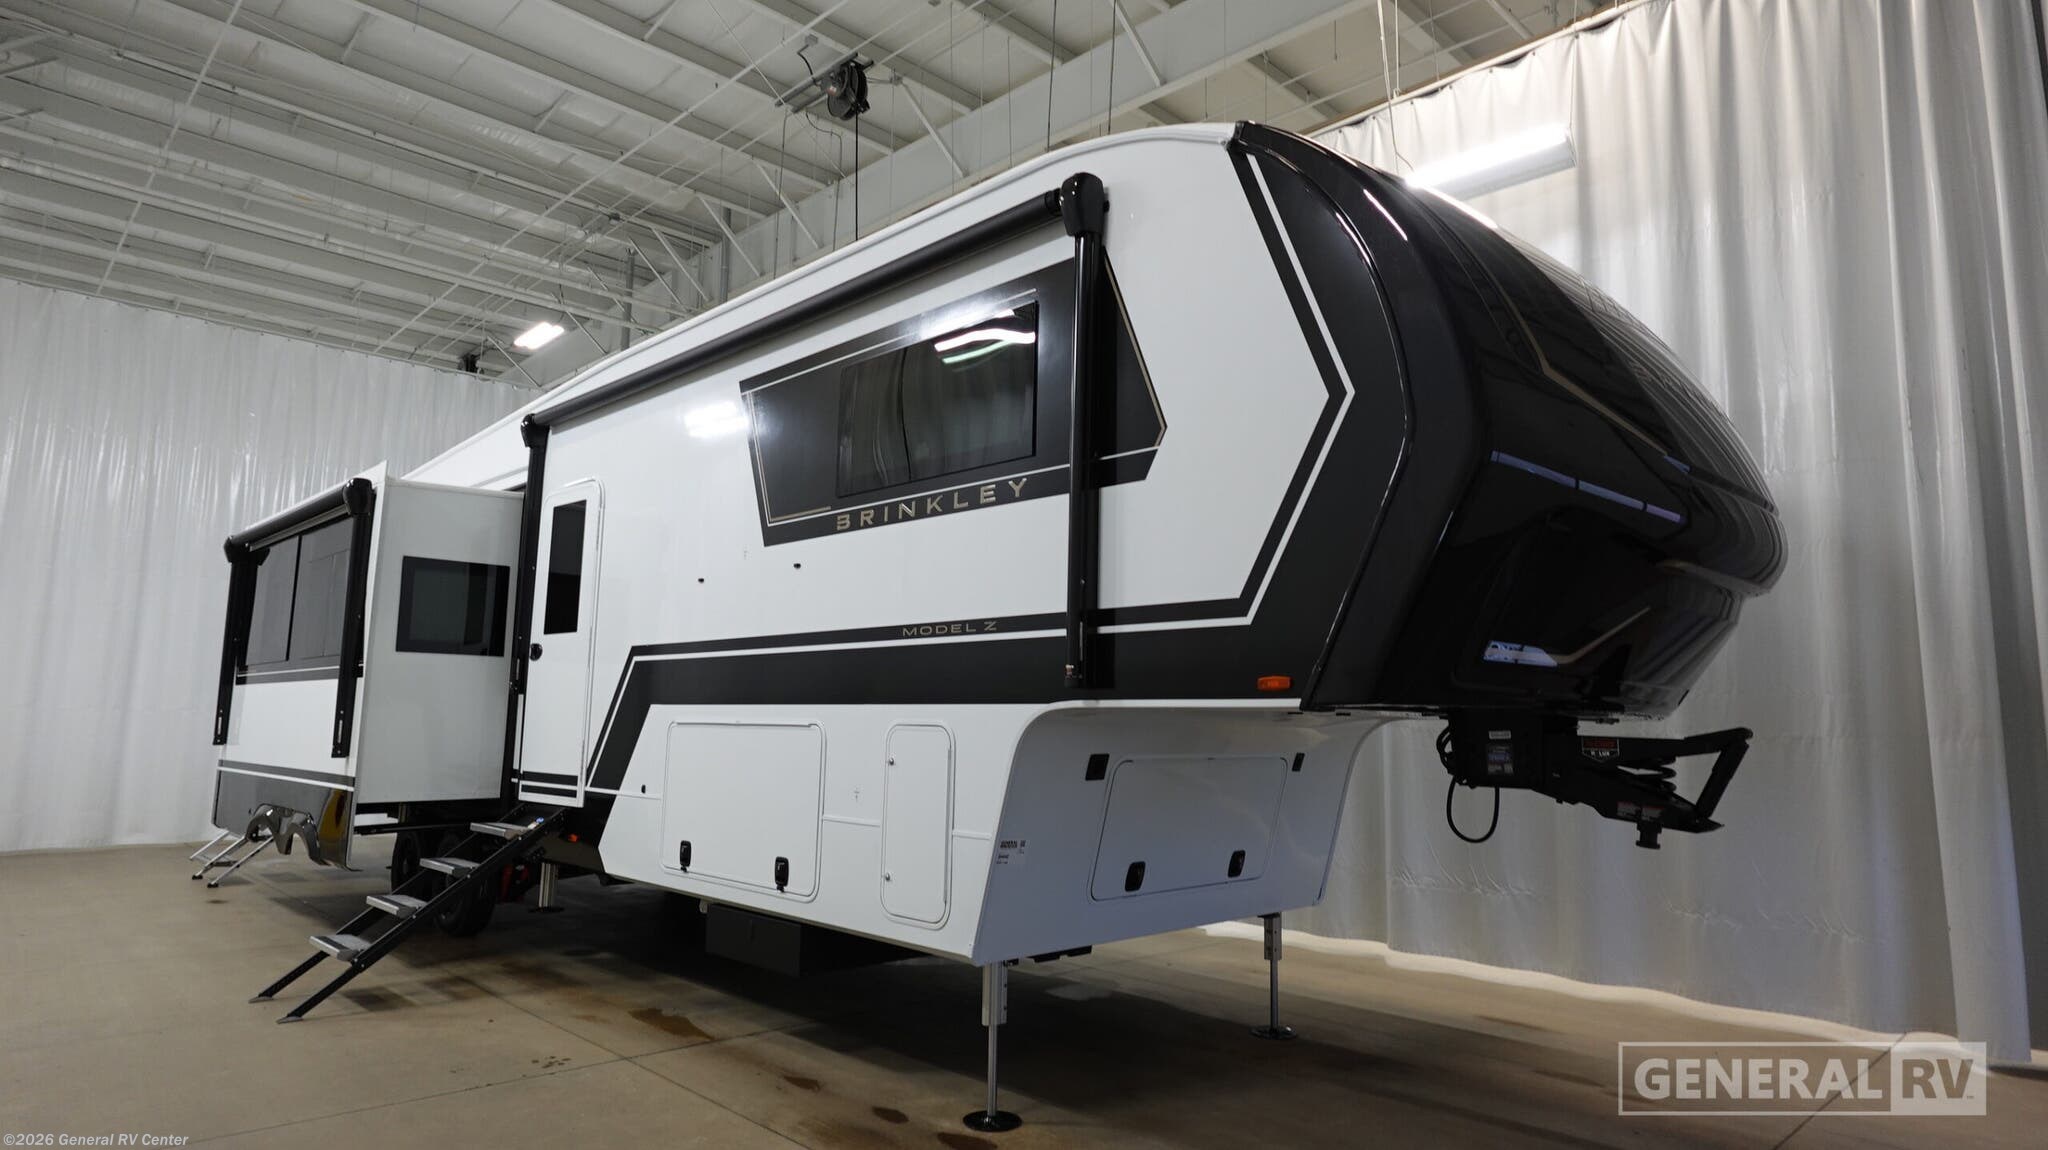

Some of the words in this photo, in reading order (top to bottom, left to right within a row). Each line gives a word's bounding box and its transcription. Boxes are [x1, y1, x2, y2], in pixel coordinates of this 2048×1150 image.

[836, 477, 1028, 532] BRINKLEY
[902, 623, 977, 637] MODEL
[984, 620, 998, 632] Z
